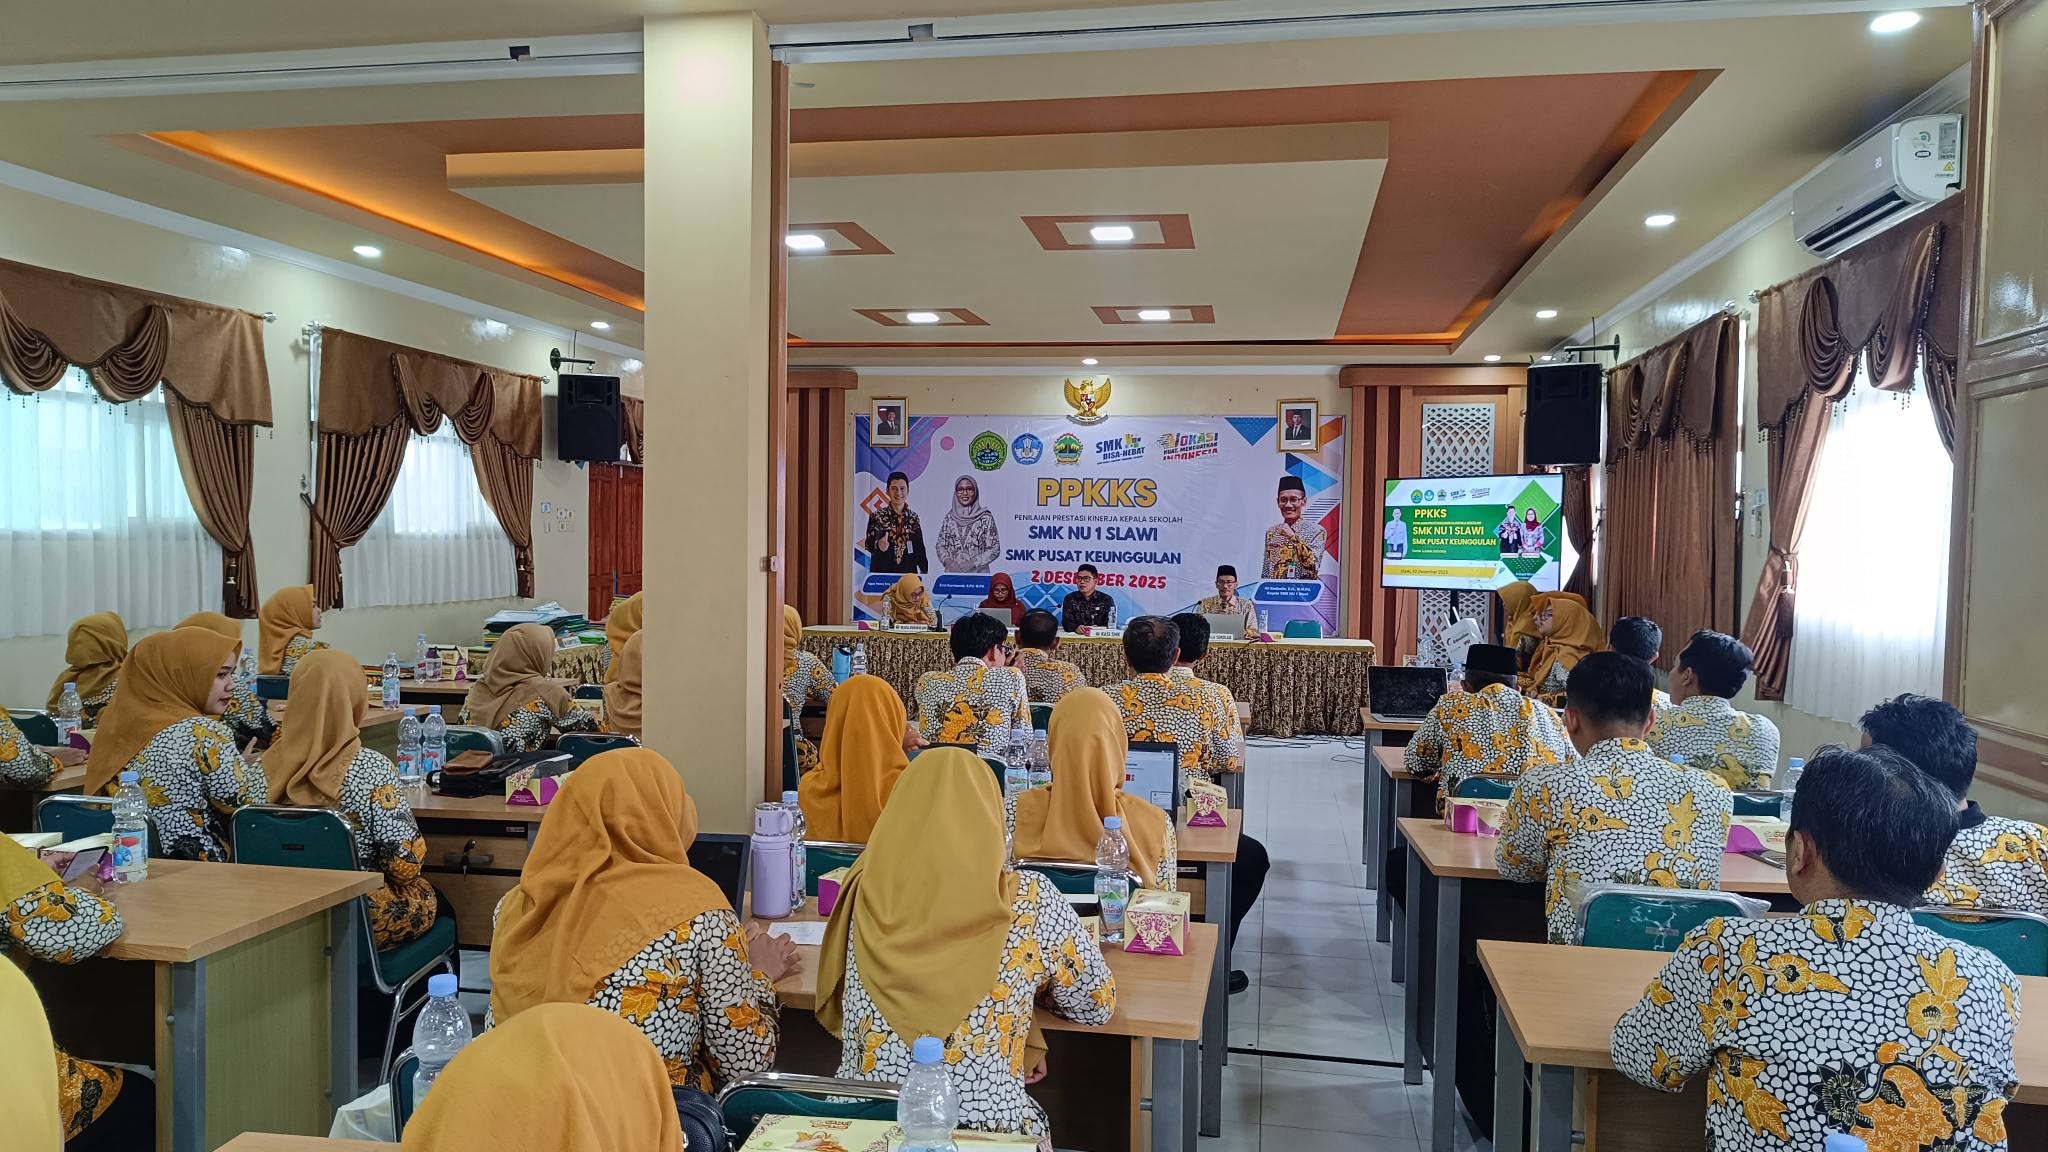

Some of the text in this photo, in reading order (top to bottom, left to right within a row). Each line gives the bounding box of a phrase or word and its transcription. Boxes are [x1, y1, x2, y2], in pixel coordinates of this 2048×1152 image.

[1095, 438, 1122, 453] SMK
[1103, 447, 1145, 460] BISA-HEBAT
[1037, 477, 1158, 508] PPKKS
[1014, 514, 1183, 524] PENILAIAN PRESTASI KINERJA KEPALA SEKOLAH
[1414, 508, 1447, 518] PPKKS
[1028, 525, 1158, 542] SMK NU 1 SLAWI
[1412, 526, 1484, 535] SMK NU 1 SLAWI
[1449, 538, 1497, 546] KEUNGGULAN
[1005, 549, 1182, 565] SMK PUSAT KEUNGGULAN
[1030, 570, 1167, 589] 2 DESEBER 2025
